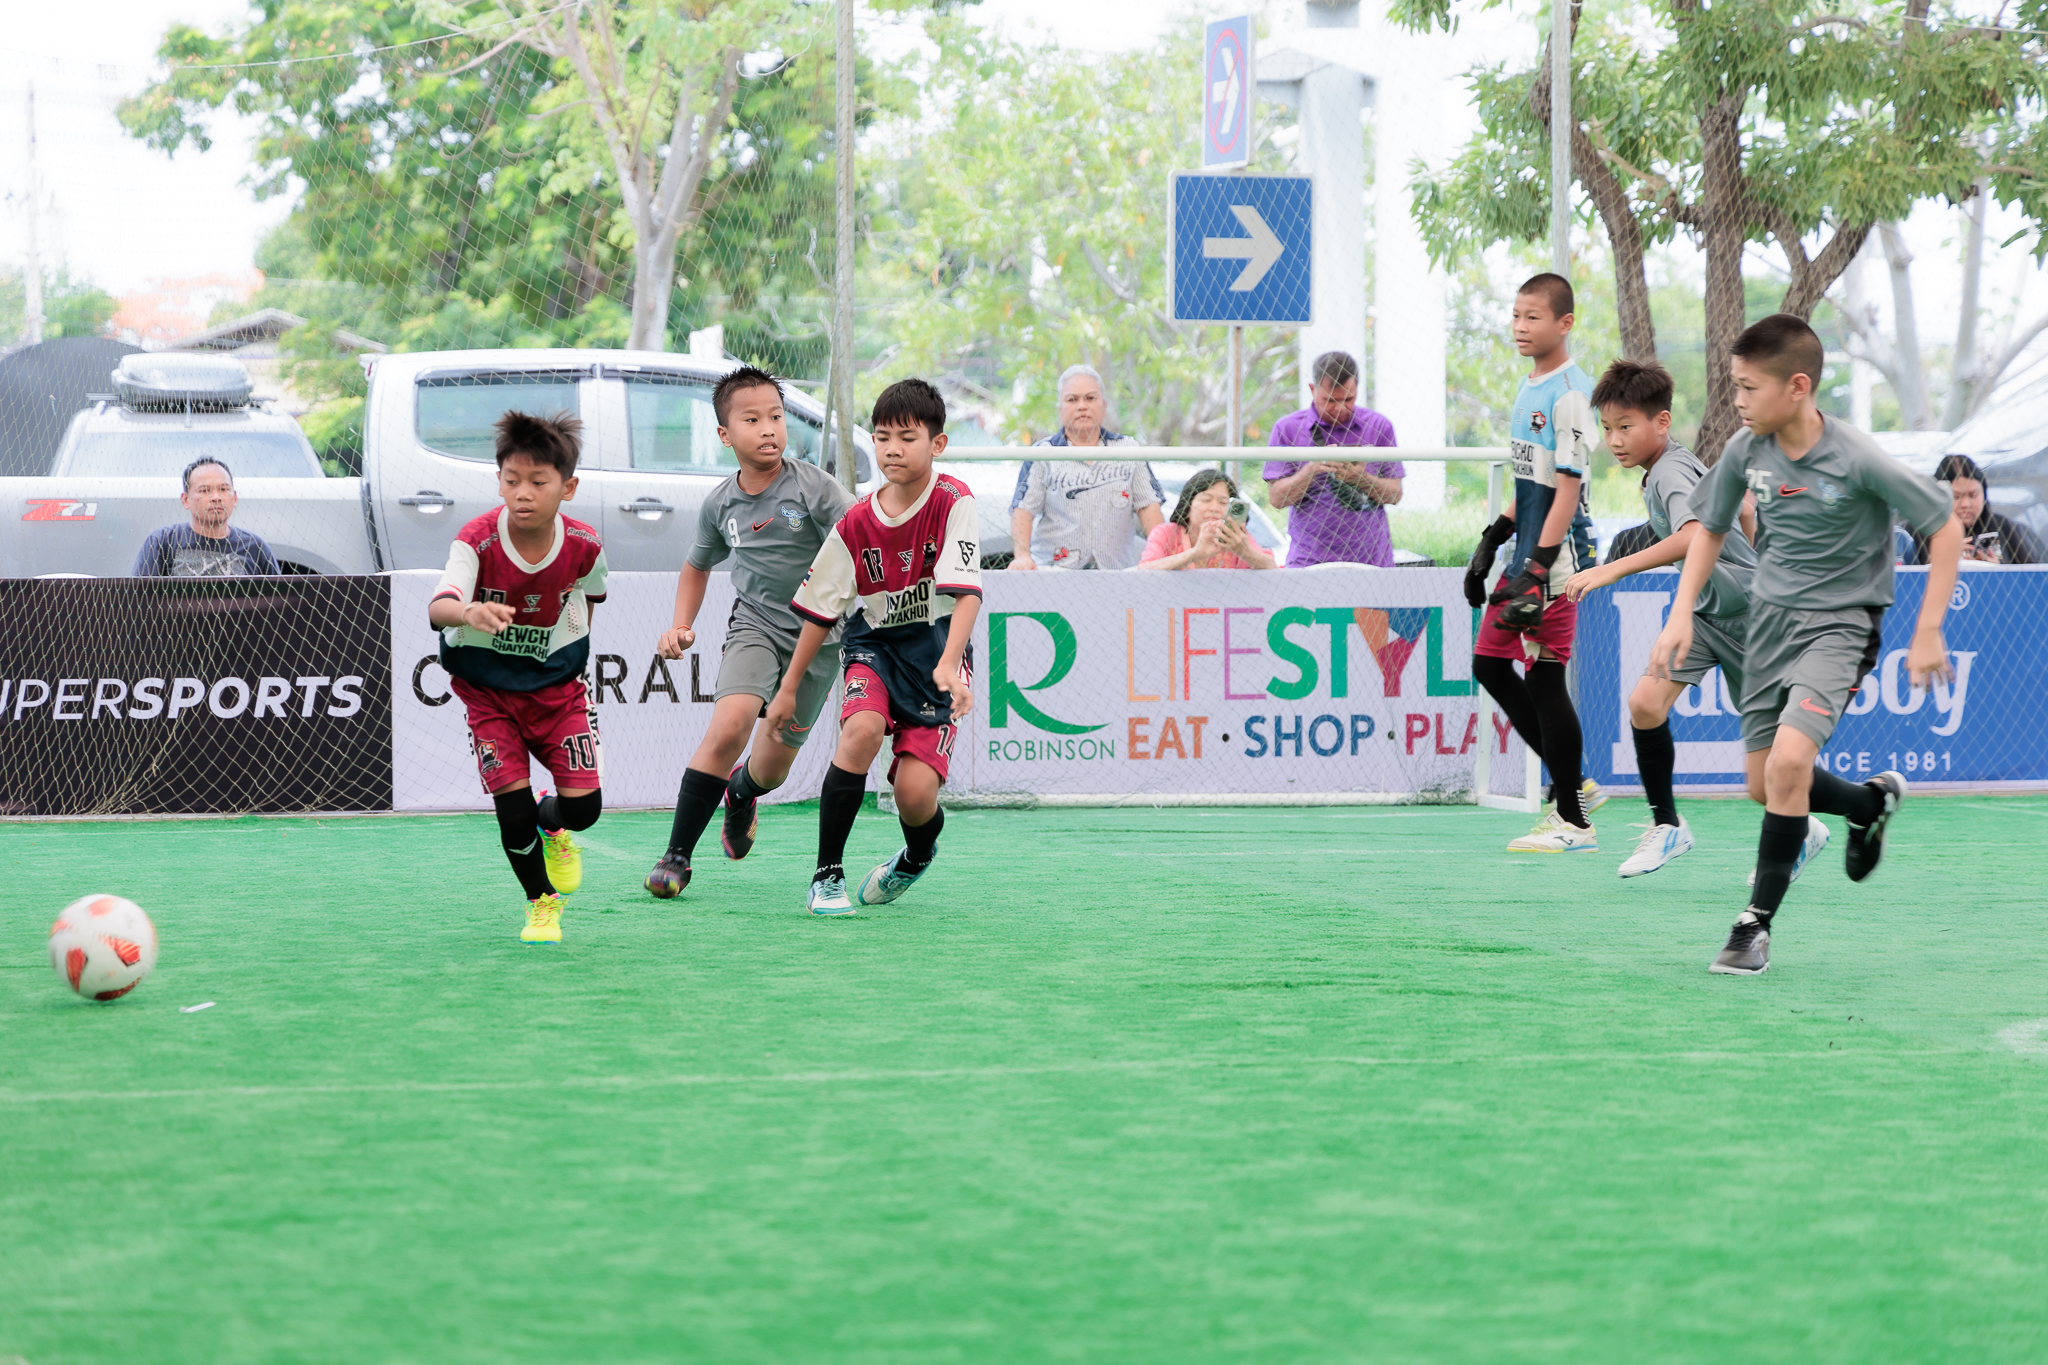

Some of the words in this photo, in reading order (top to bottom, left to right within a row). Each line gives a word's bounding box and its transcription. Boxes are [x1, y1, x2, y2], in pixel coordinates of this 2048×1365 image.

[22, 499, 98, 521] Z71
[727, 517, 741, 548] 9
[1127, 606, 1480, 702] LIFESTYL
[411, 654, 716, 707] CRAL
[561, 732, 597, 771] 10
[989, 738, 1115, 761] ROBINSON
[1128, 716, 1209, 760] EAT
[1244, 714, 1375, 758] SHOP
[1813, 751, 1871, 773] NCE
[1887, 750, 1951, 773] 1981
